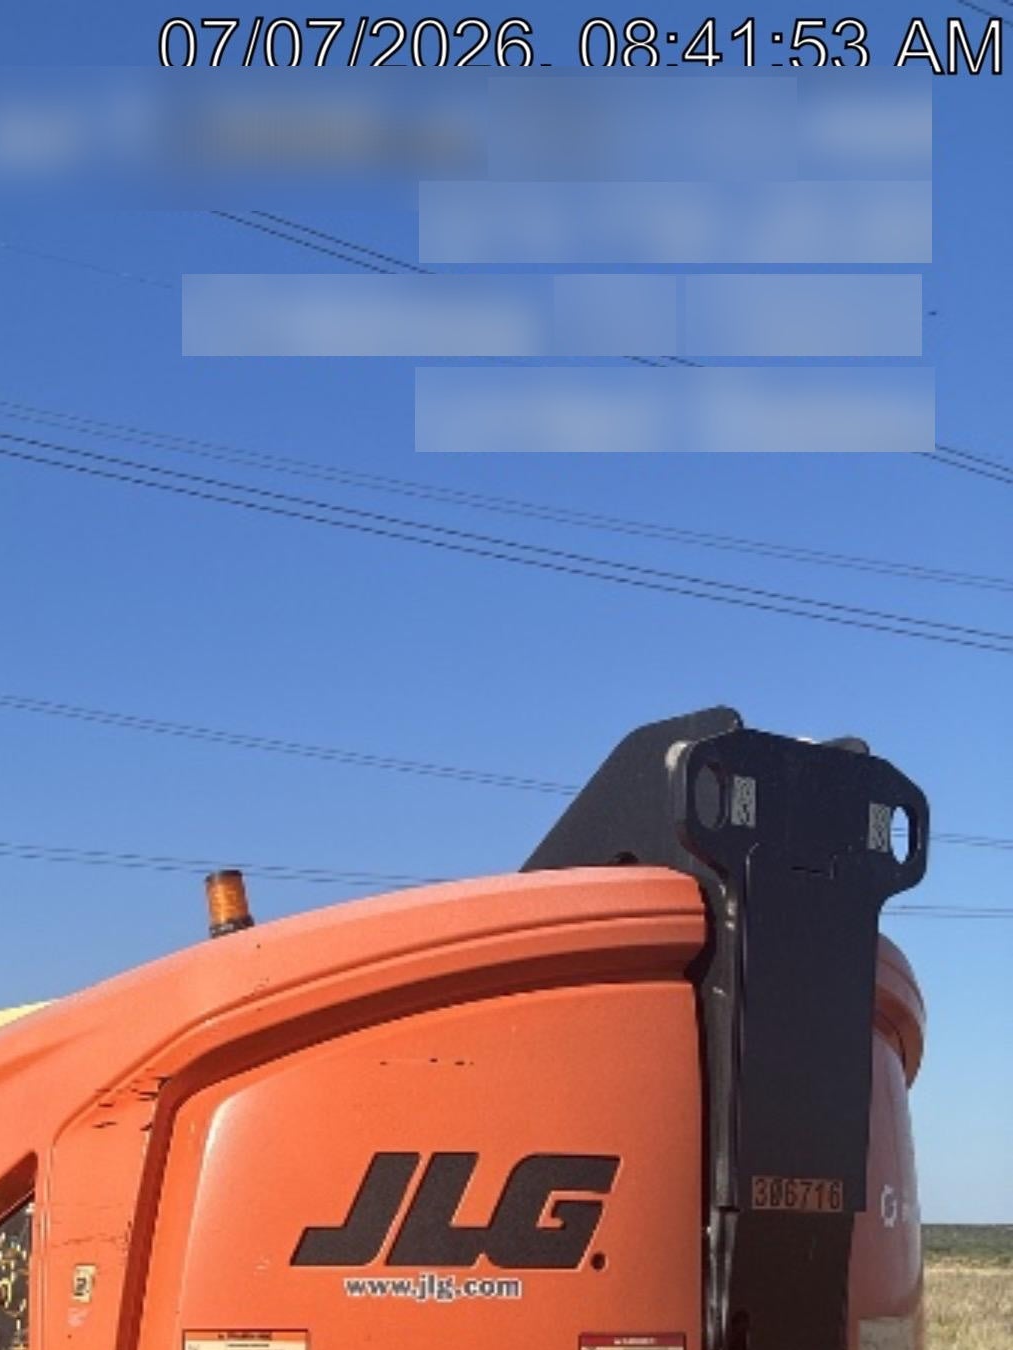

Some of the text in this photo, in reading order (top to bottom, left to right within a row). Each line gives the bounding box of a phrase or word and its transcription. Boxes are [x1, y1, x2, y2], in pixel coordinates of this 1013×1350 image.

[754, 1177, 842, 1210] 306716
[290, 1151, 621, 1270] JLG
[344, 1272, 522, 1301] www.jlg.com
